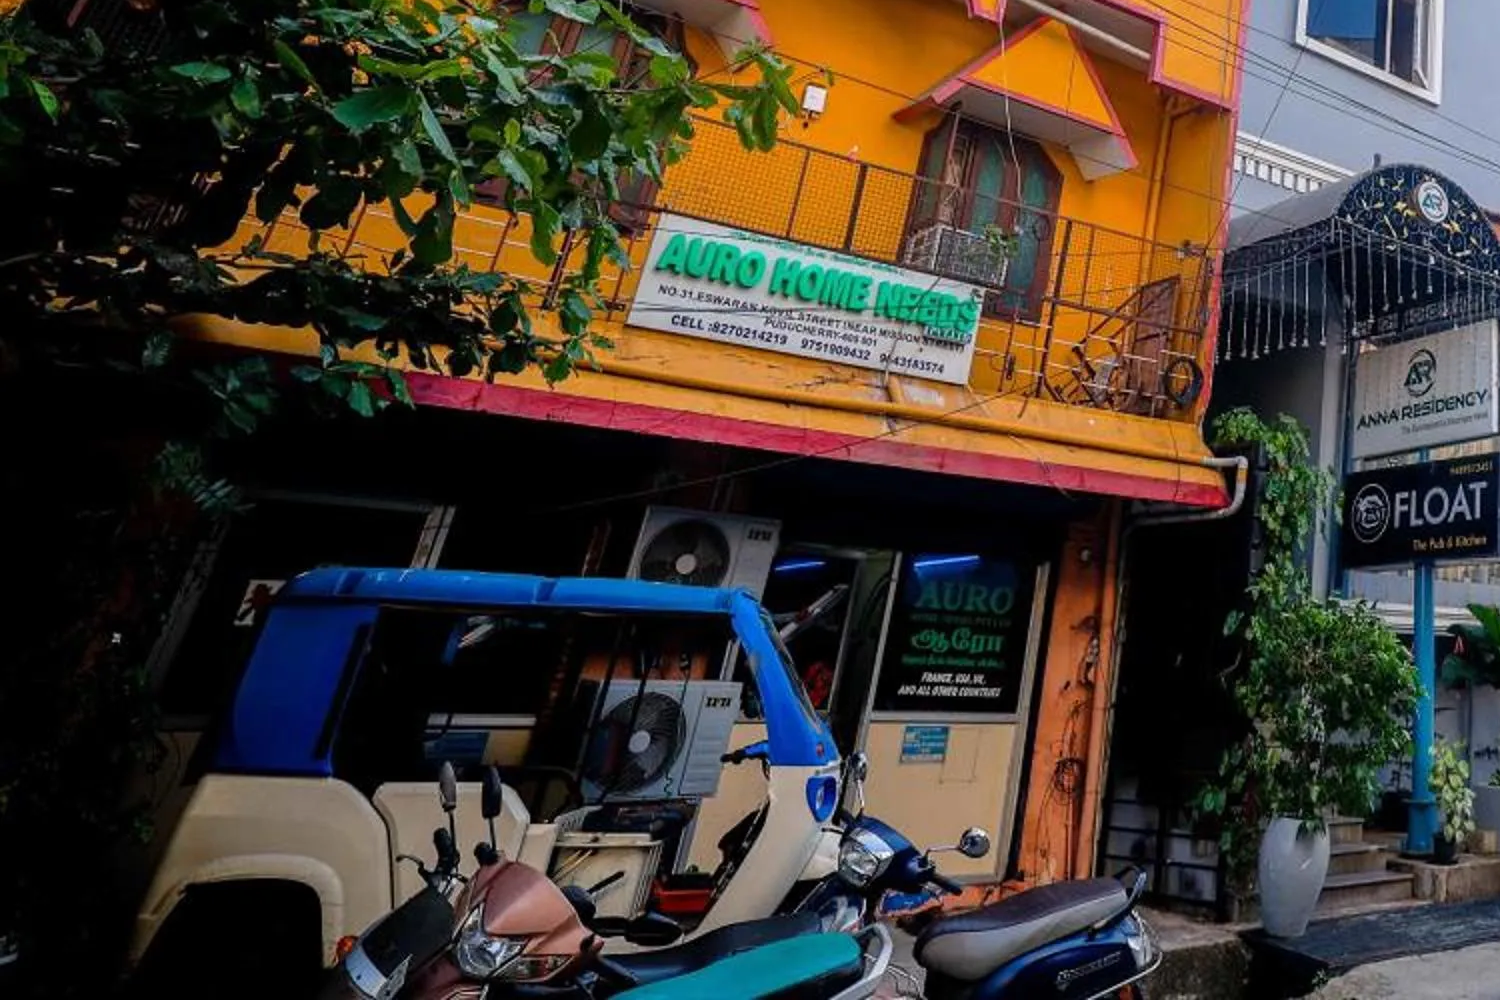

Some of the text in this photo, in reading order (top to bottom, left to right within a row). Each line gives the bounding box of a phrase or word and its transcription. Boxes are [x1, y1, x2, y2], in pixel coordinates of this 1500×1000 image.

[655, 233, 767, 288] AURO
[768, 256, 873, 315] HOME
[874, 279, 979, 332] NEEDS
[671, 314, 705, 331] CELL
[1356, 408, 1399, 431] ANNA
[1400, 389, 1489, 421] RESIDENCY
[1393, 481, 1489, 530] FLOAT
[914, 580, 1014, 615] AURO
